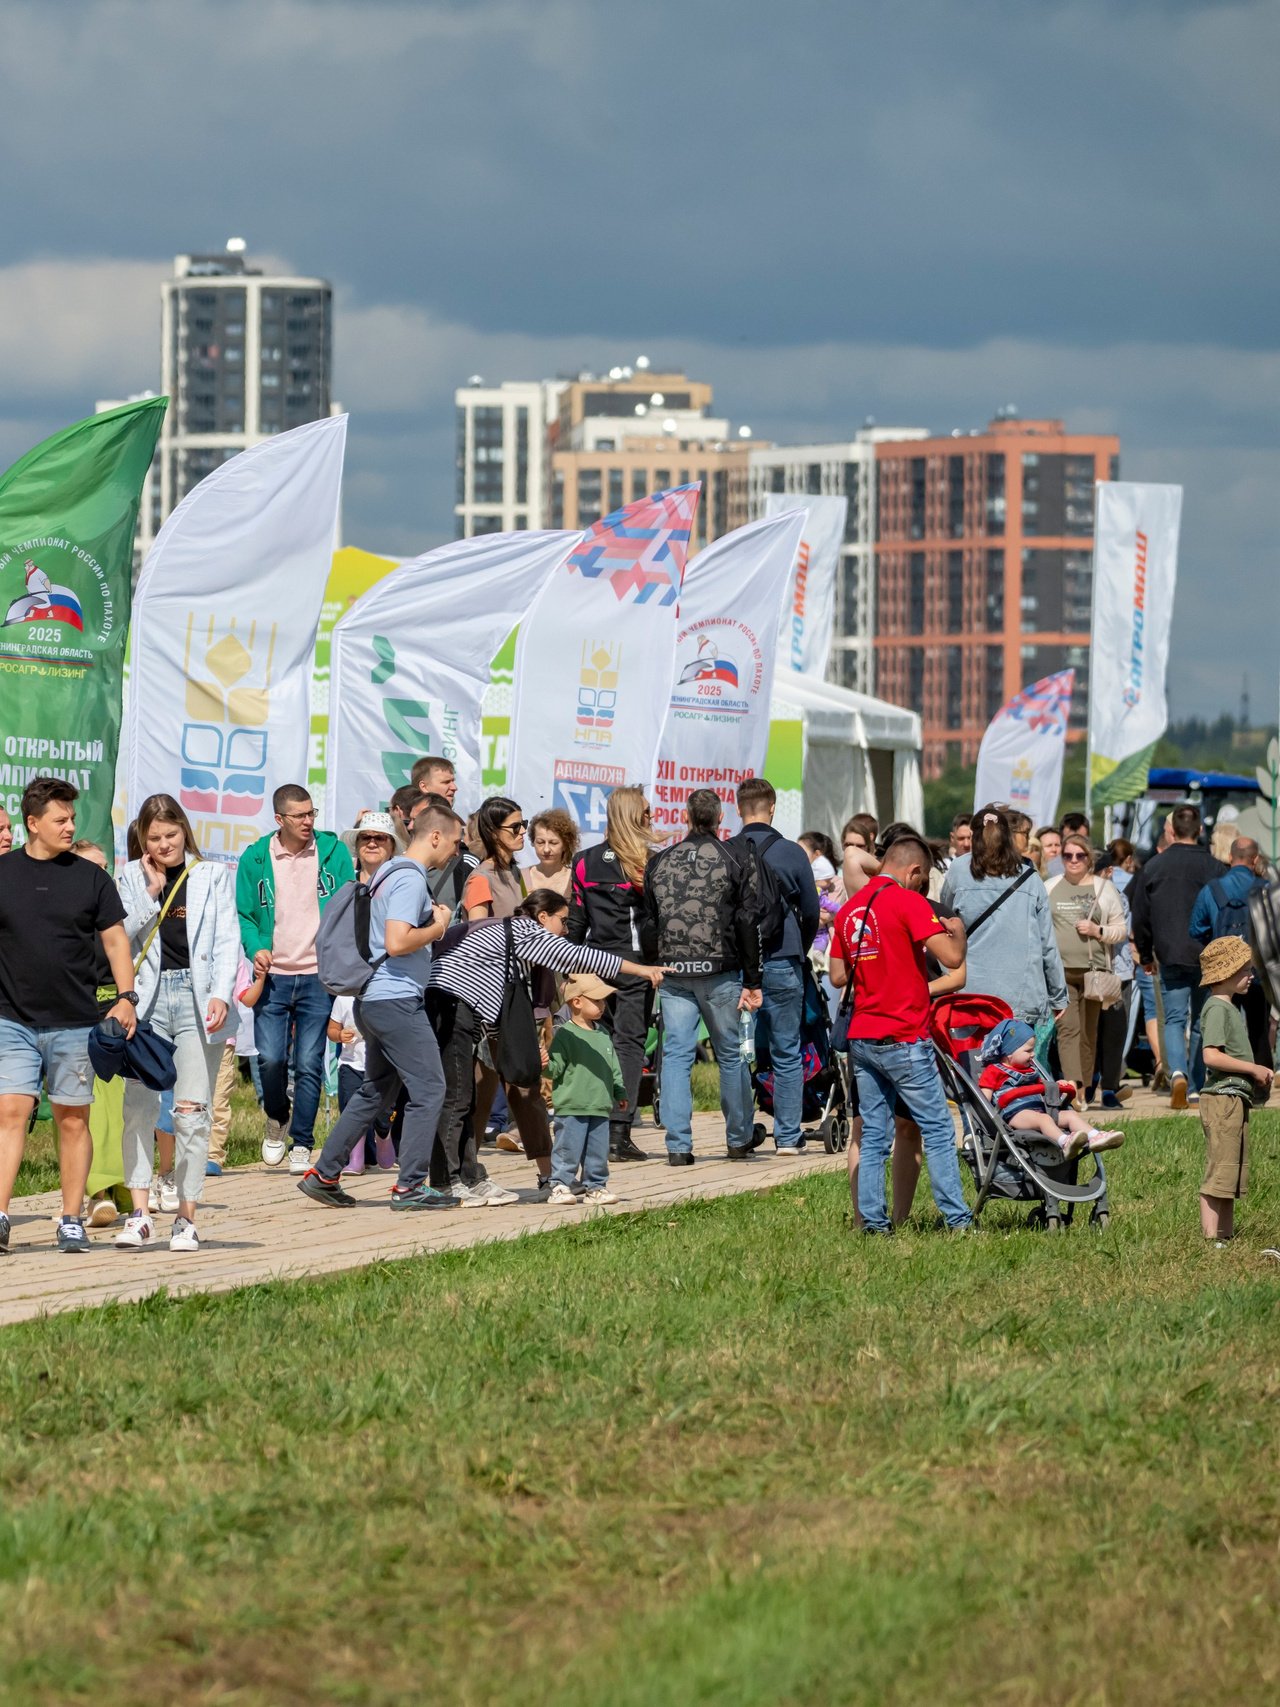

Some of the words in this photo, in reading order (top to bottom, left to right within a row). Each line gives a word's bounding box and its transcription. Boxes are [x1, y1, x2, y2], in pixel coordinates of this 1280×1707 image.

[11, 537, 71, 555] ЧЕМПИОНАТ
[71, 545, 105, 580] РОССИИ
[100, 582, 111, 597] ПО
[97, 601, 113, 644] ПАХОТЕ
[688, 618, 737, 632] ЧЕМПИОНАТ
[28, 627, 62, 642] 2025
[60, 647, 94, 659] ОБЛАСТЬ
[753, 648, 762, 660] ПО
[750, 662, 763, 695] ПАХОТЕ
[697, 685, 722, 696] 2025
[720, 699, 749, 708] ОБЛАСТЬ
[4, 736, 104, 762] ОТКРЫТЫЙ
[680, 766, 755, 784] ОТКРЫТЫЙ
